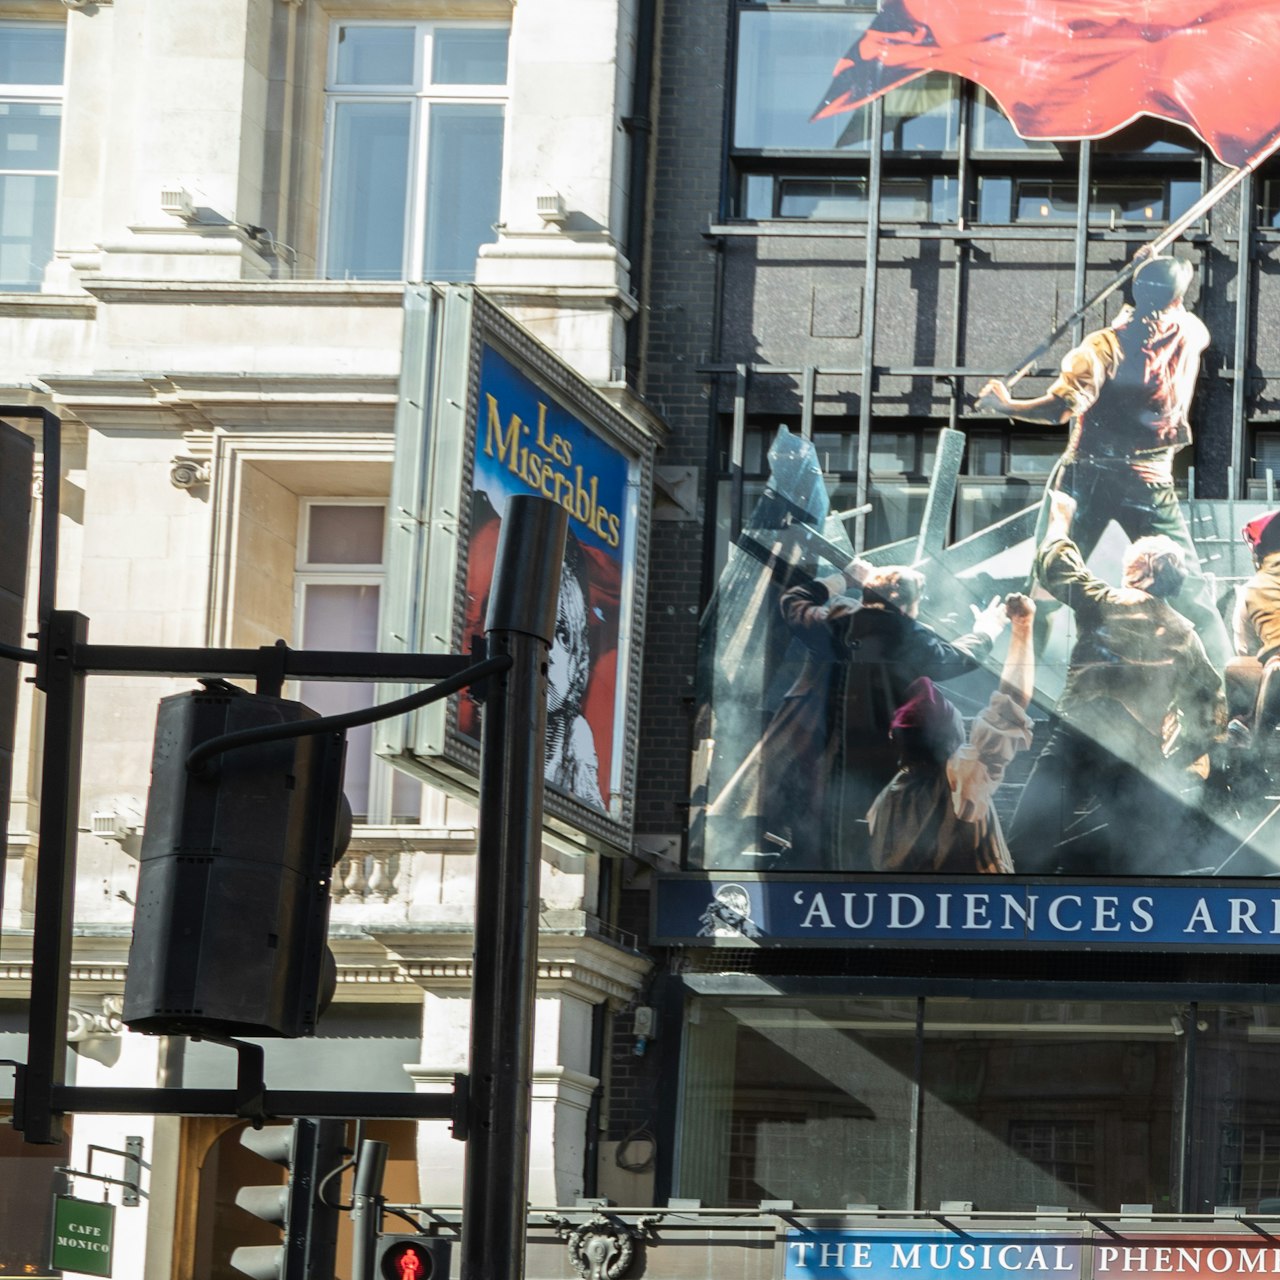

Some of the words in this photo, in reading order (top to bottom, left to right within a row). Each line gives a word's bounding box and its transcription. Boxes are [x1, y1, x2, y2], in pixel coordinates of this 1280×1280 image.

[536, 401, 572, 467] Les
[483, 392, 620, 547] Misérables
[57, 1236, 110, 1253] MONICO
[68, 1223, 102, 1237] CAFE
[790, 1242, 872, 1270] THE
[891, 1243, 1074, 1272] MUSICAL
